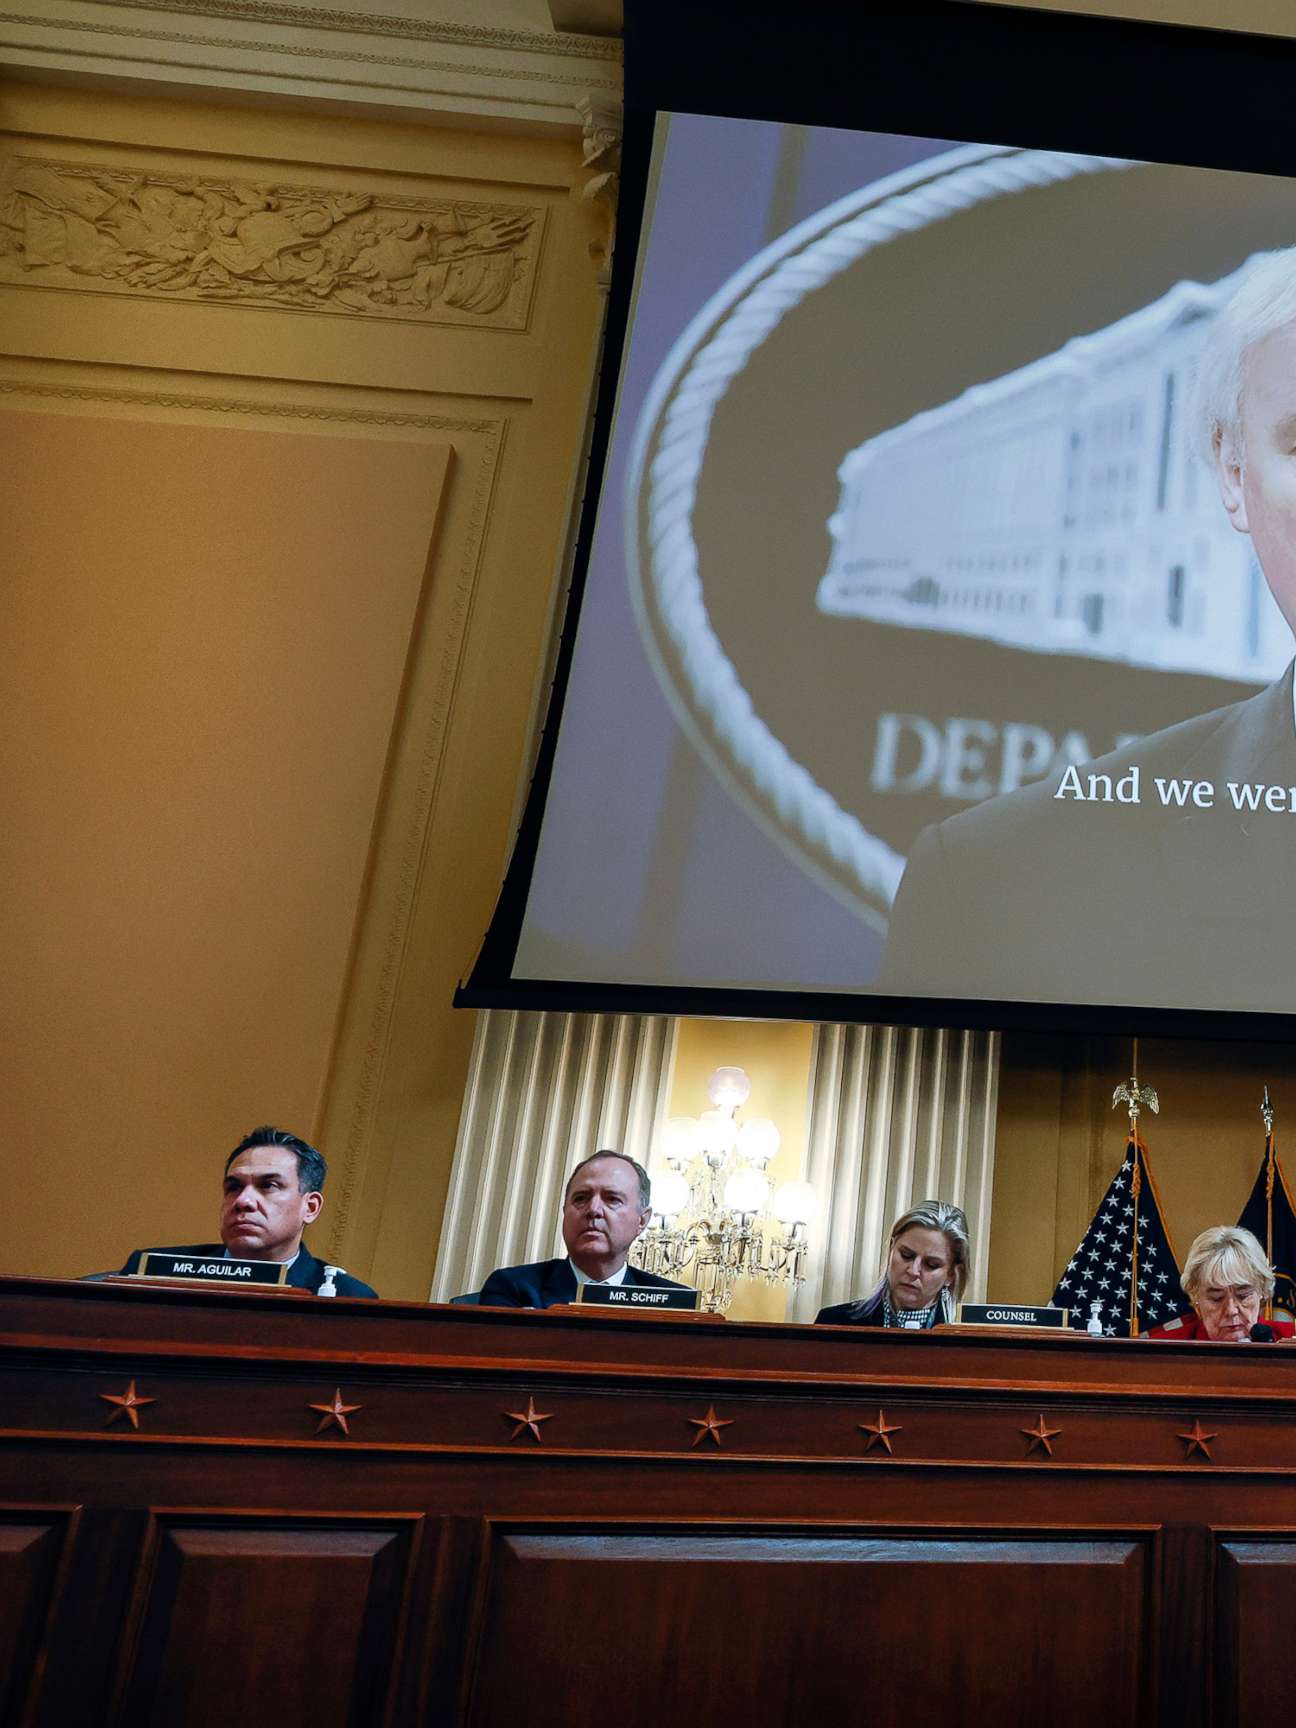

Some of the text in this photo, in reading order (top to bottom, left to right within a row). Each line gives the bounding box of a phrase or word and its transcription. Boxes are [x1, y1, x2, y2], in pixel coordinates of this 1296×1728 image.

[870, 713, 1146, 800] DEPA
[1054, 766, 1141, 804] And
[1154, 778, 1214, 808] we
[173, 1262, 252, 1277] MR. AGUILAR
[609, 1291, 669, 1304] MR. SCHIFF
[986, 1310, 1037, 1322] COUNSEL
